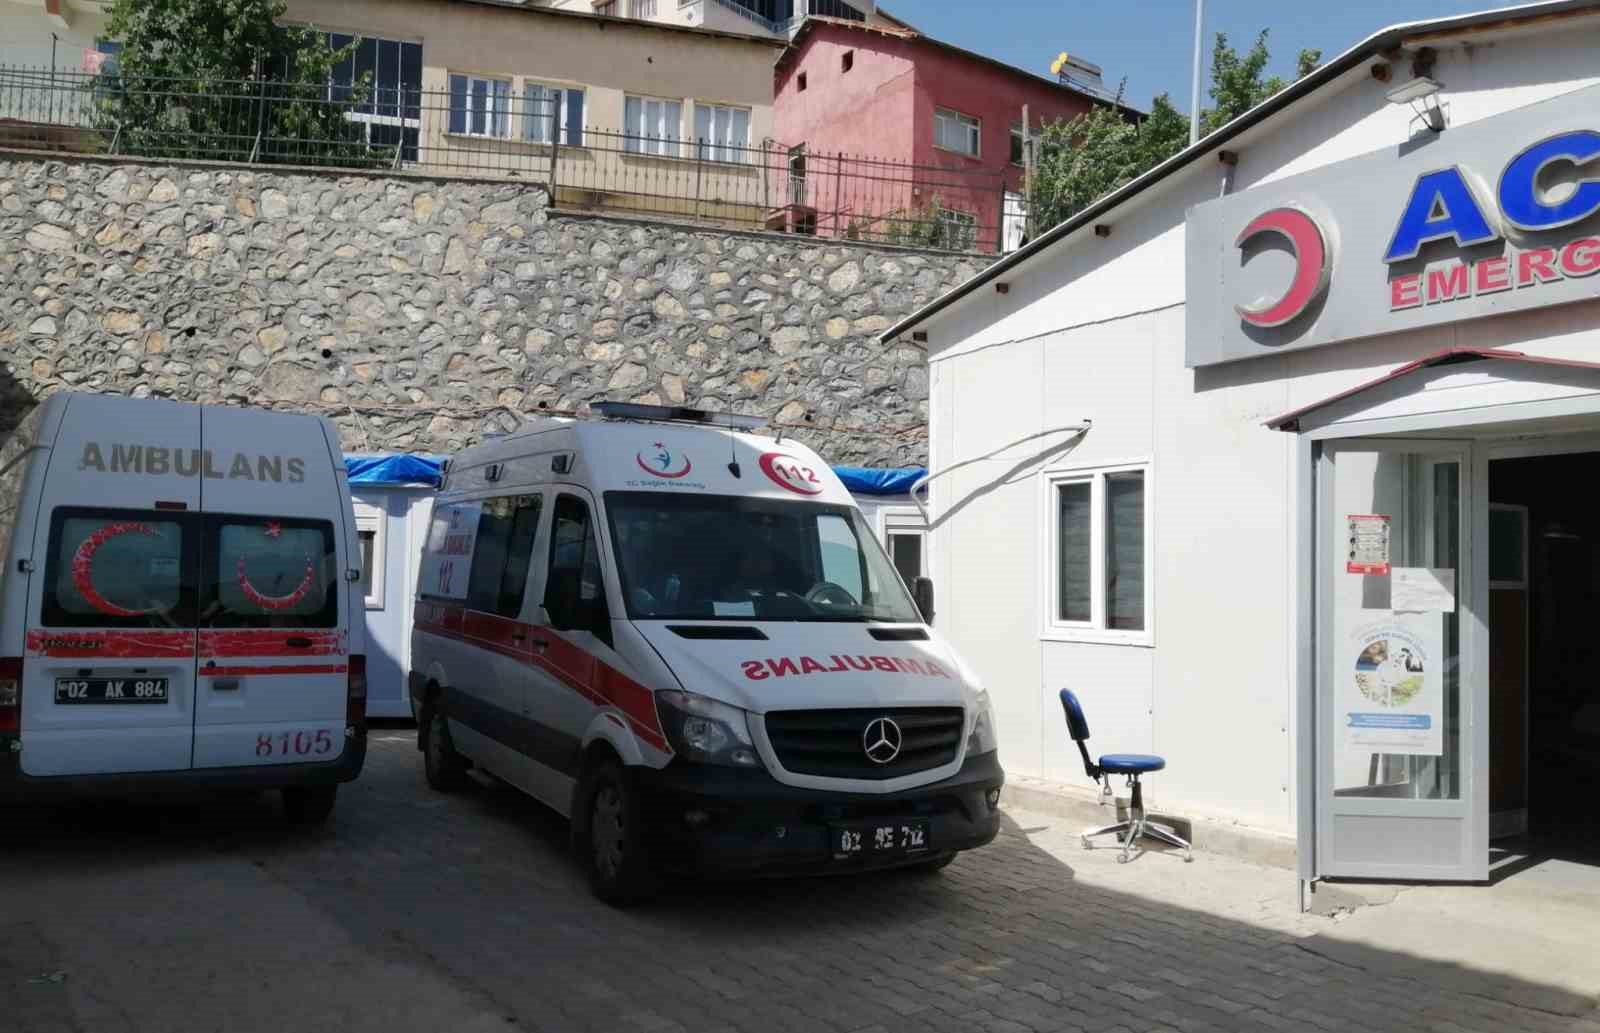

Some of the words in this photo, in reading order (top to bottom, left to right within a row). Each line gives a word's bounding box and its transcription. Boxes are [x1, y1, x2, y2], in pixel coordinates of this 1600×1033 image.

[1383, 130, 1600, 263] AC
[1391, 236, 1600, 310] EMERG
[77, 441, 305, 483] AMBULANS
[775, 463, 821, 483] 112
[67, 681, 88, 698] 02
[105, 681, 124, 698] AK
[135, 681, 164, 697] 884
[255, 729, 331, 757] 8105
